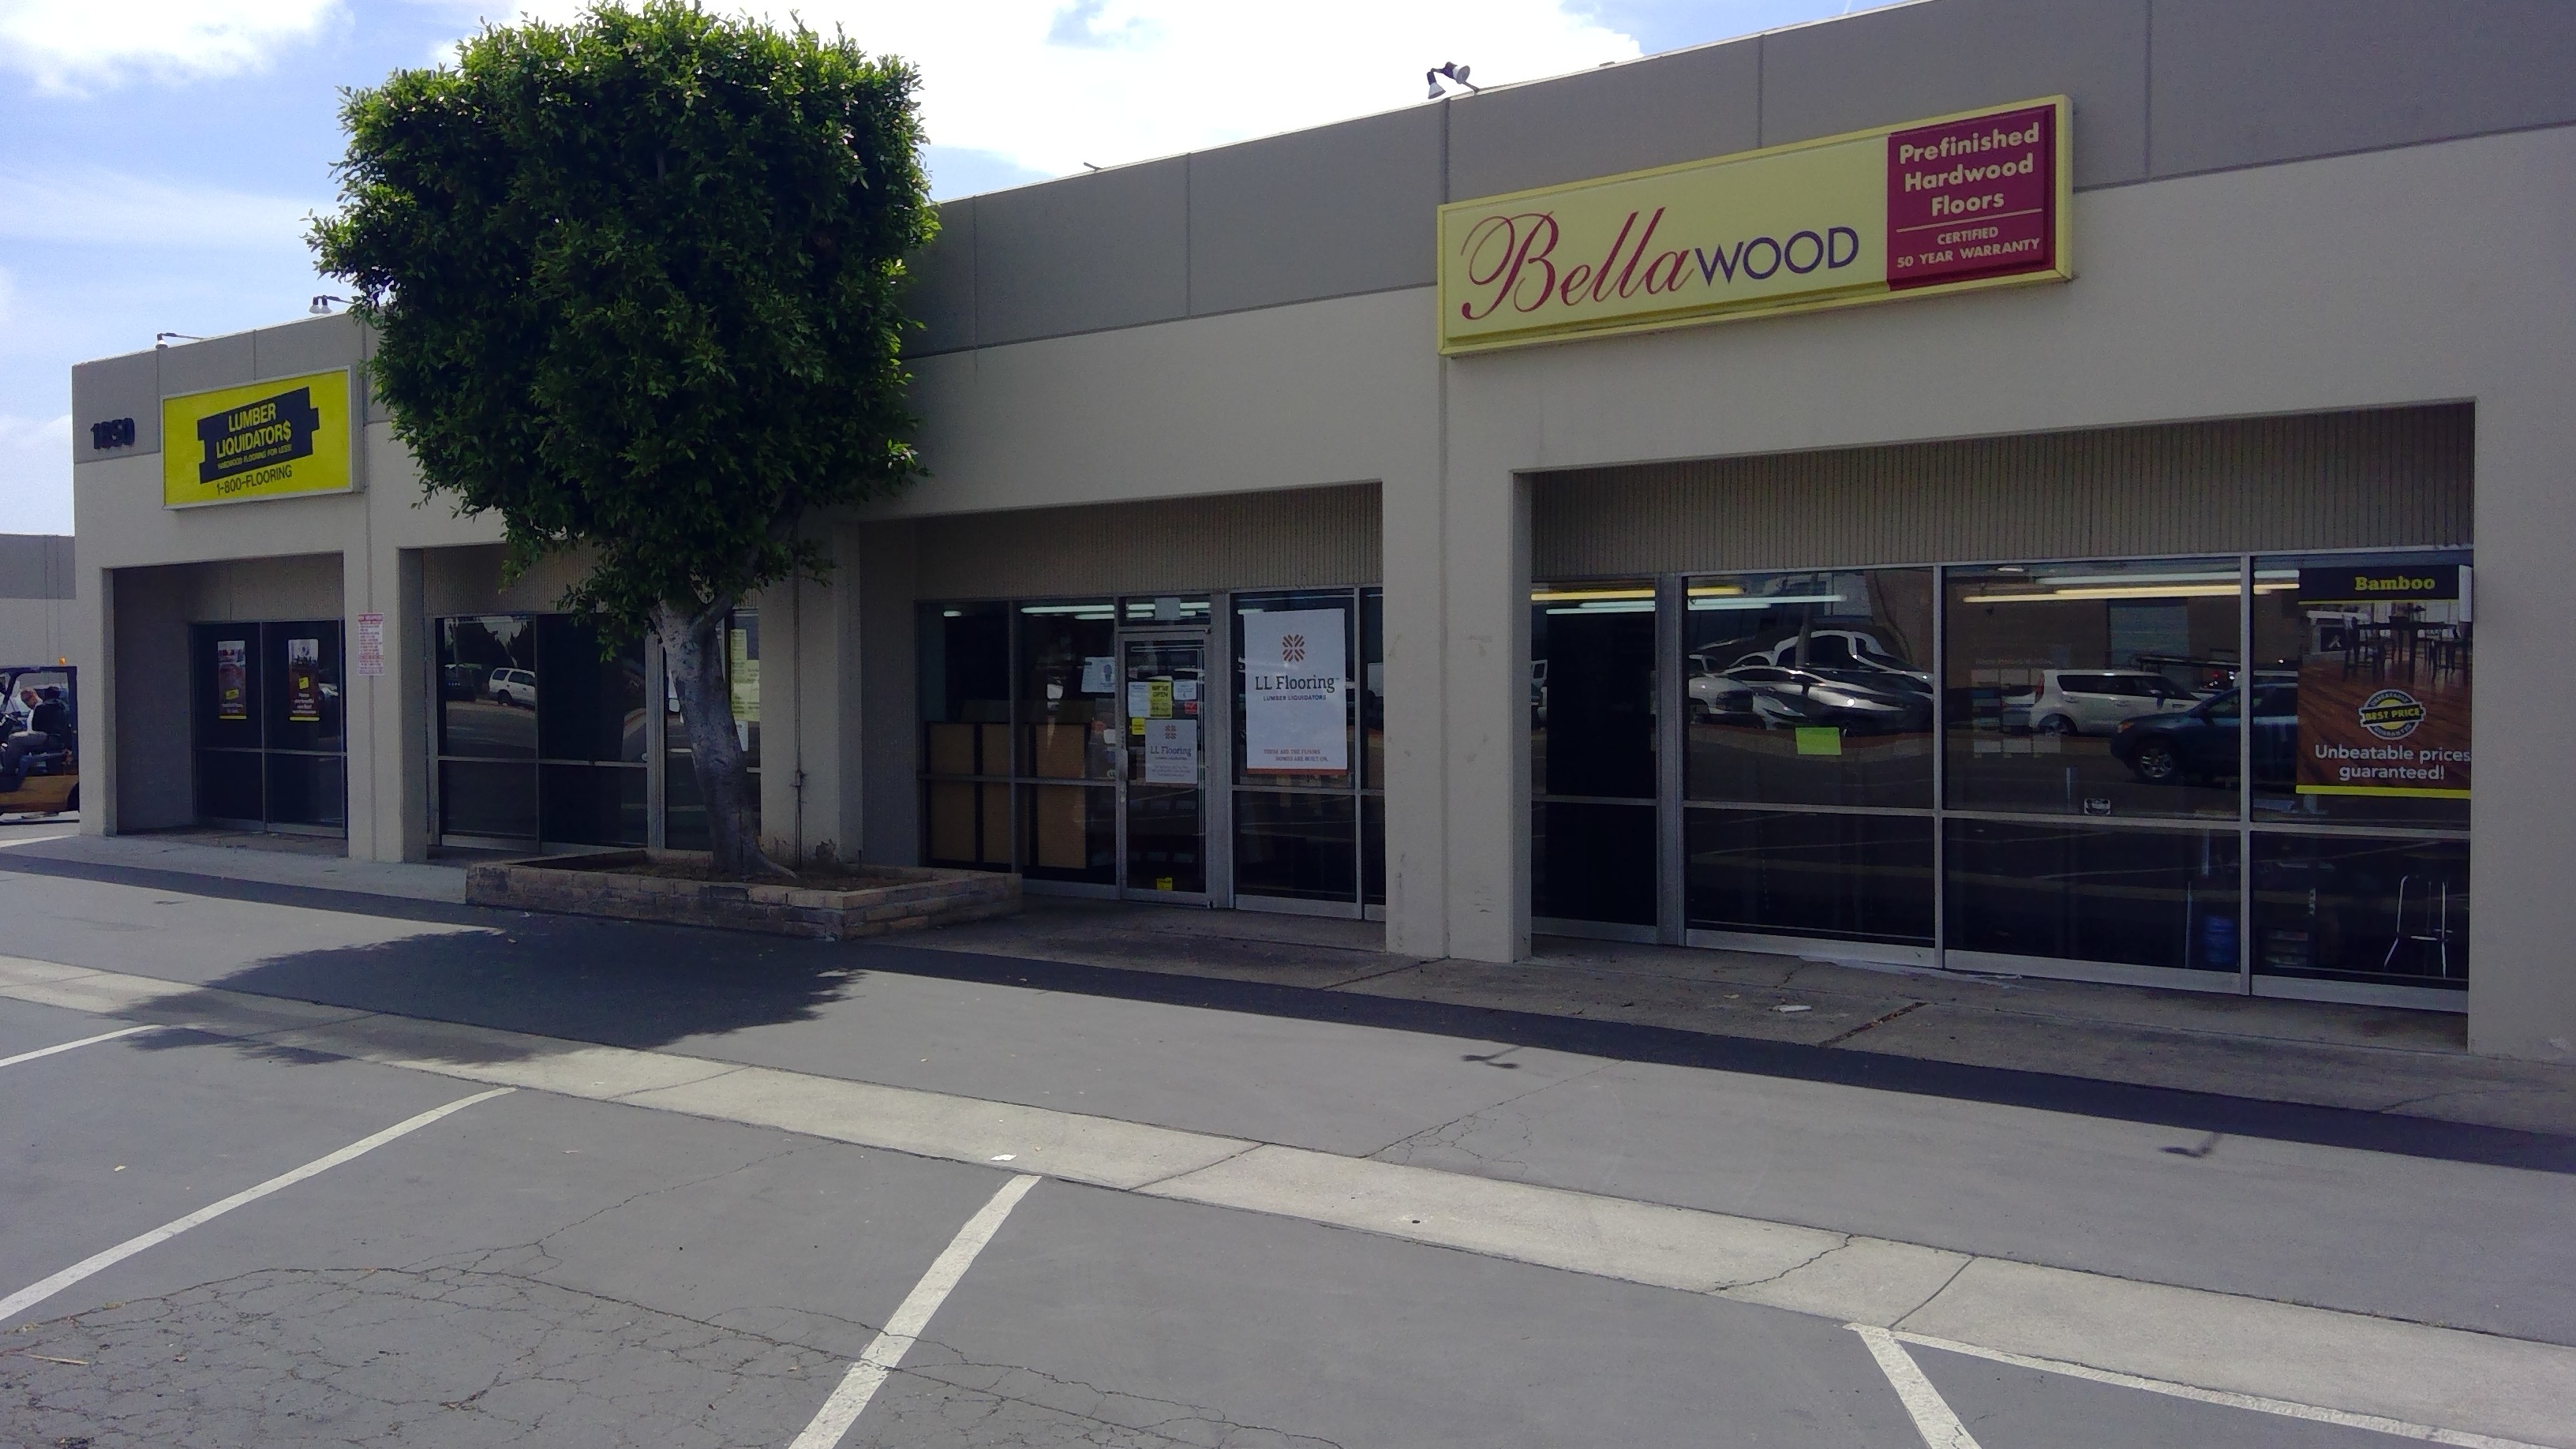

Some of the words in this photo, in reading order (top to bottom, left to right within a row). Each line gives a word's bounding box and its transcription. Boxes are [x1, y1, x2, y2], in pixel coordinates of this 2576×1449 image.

[1899, 129, 2039, 164] Prefinished
[1904, 159, 2033, 192] Hardwood
[1930, 193, 2005, 216] Floors
[1936, 227, 1999, 245] CERTIFIED
[1896, 255, 1914, 268] 50
[1919, 249, 1954, 265] YEAR
[1959, 238, 2040, 260] WARRANTY
[228, 402, 276, 432] LUMBER
[215, 464, 293, 496] 1-800-FLOORING
[2354, 575, 2436, 591] Bamboo
[1255, 676, 1272, 690] LL
[1275, 674, 1335, 693] Flooring
[2364, 710, 2388, 721] BEST
[2391, 707, 2421, 718] PRICE
[1161, 746, 1192, 758] Flooring
[2314, 744, 2414, 761] Unbeatable
[2338, 765, 2445, 782] guaranteed!
